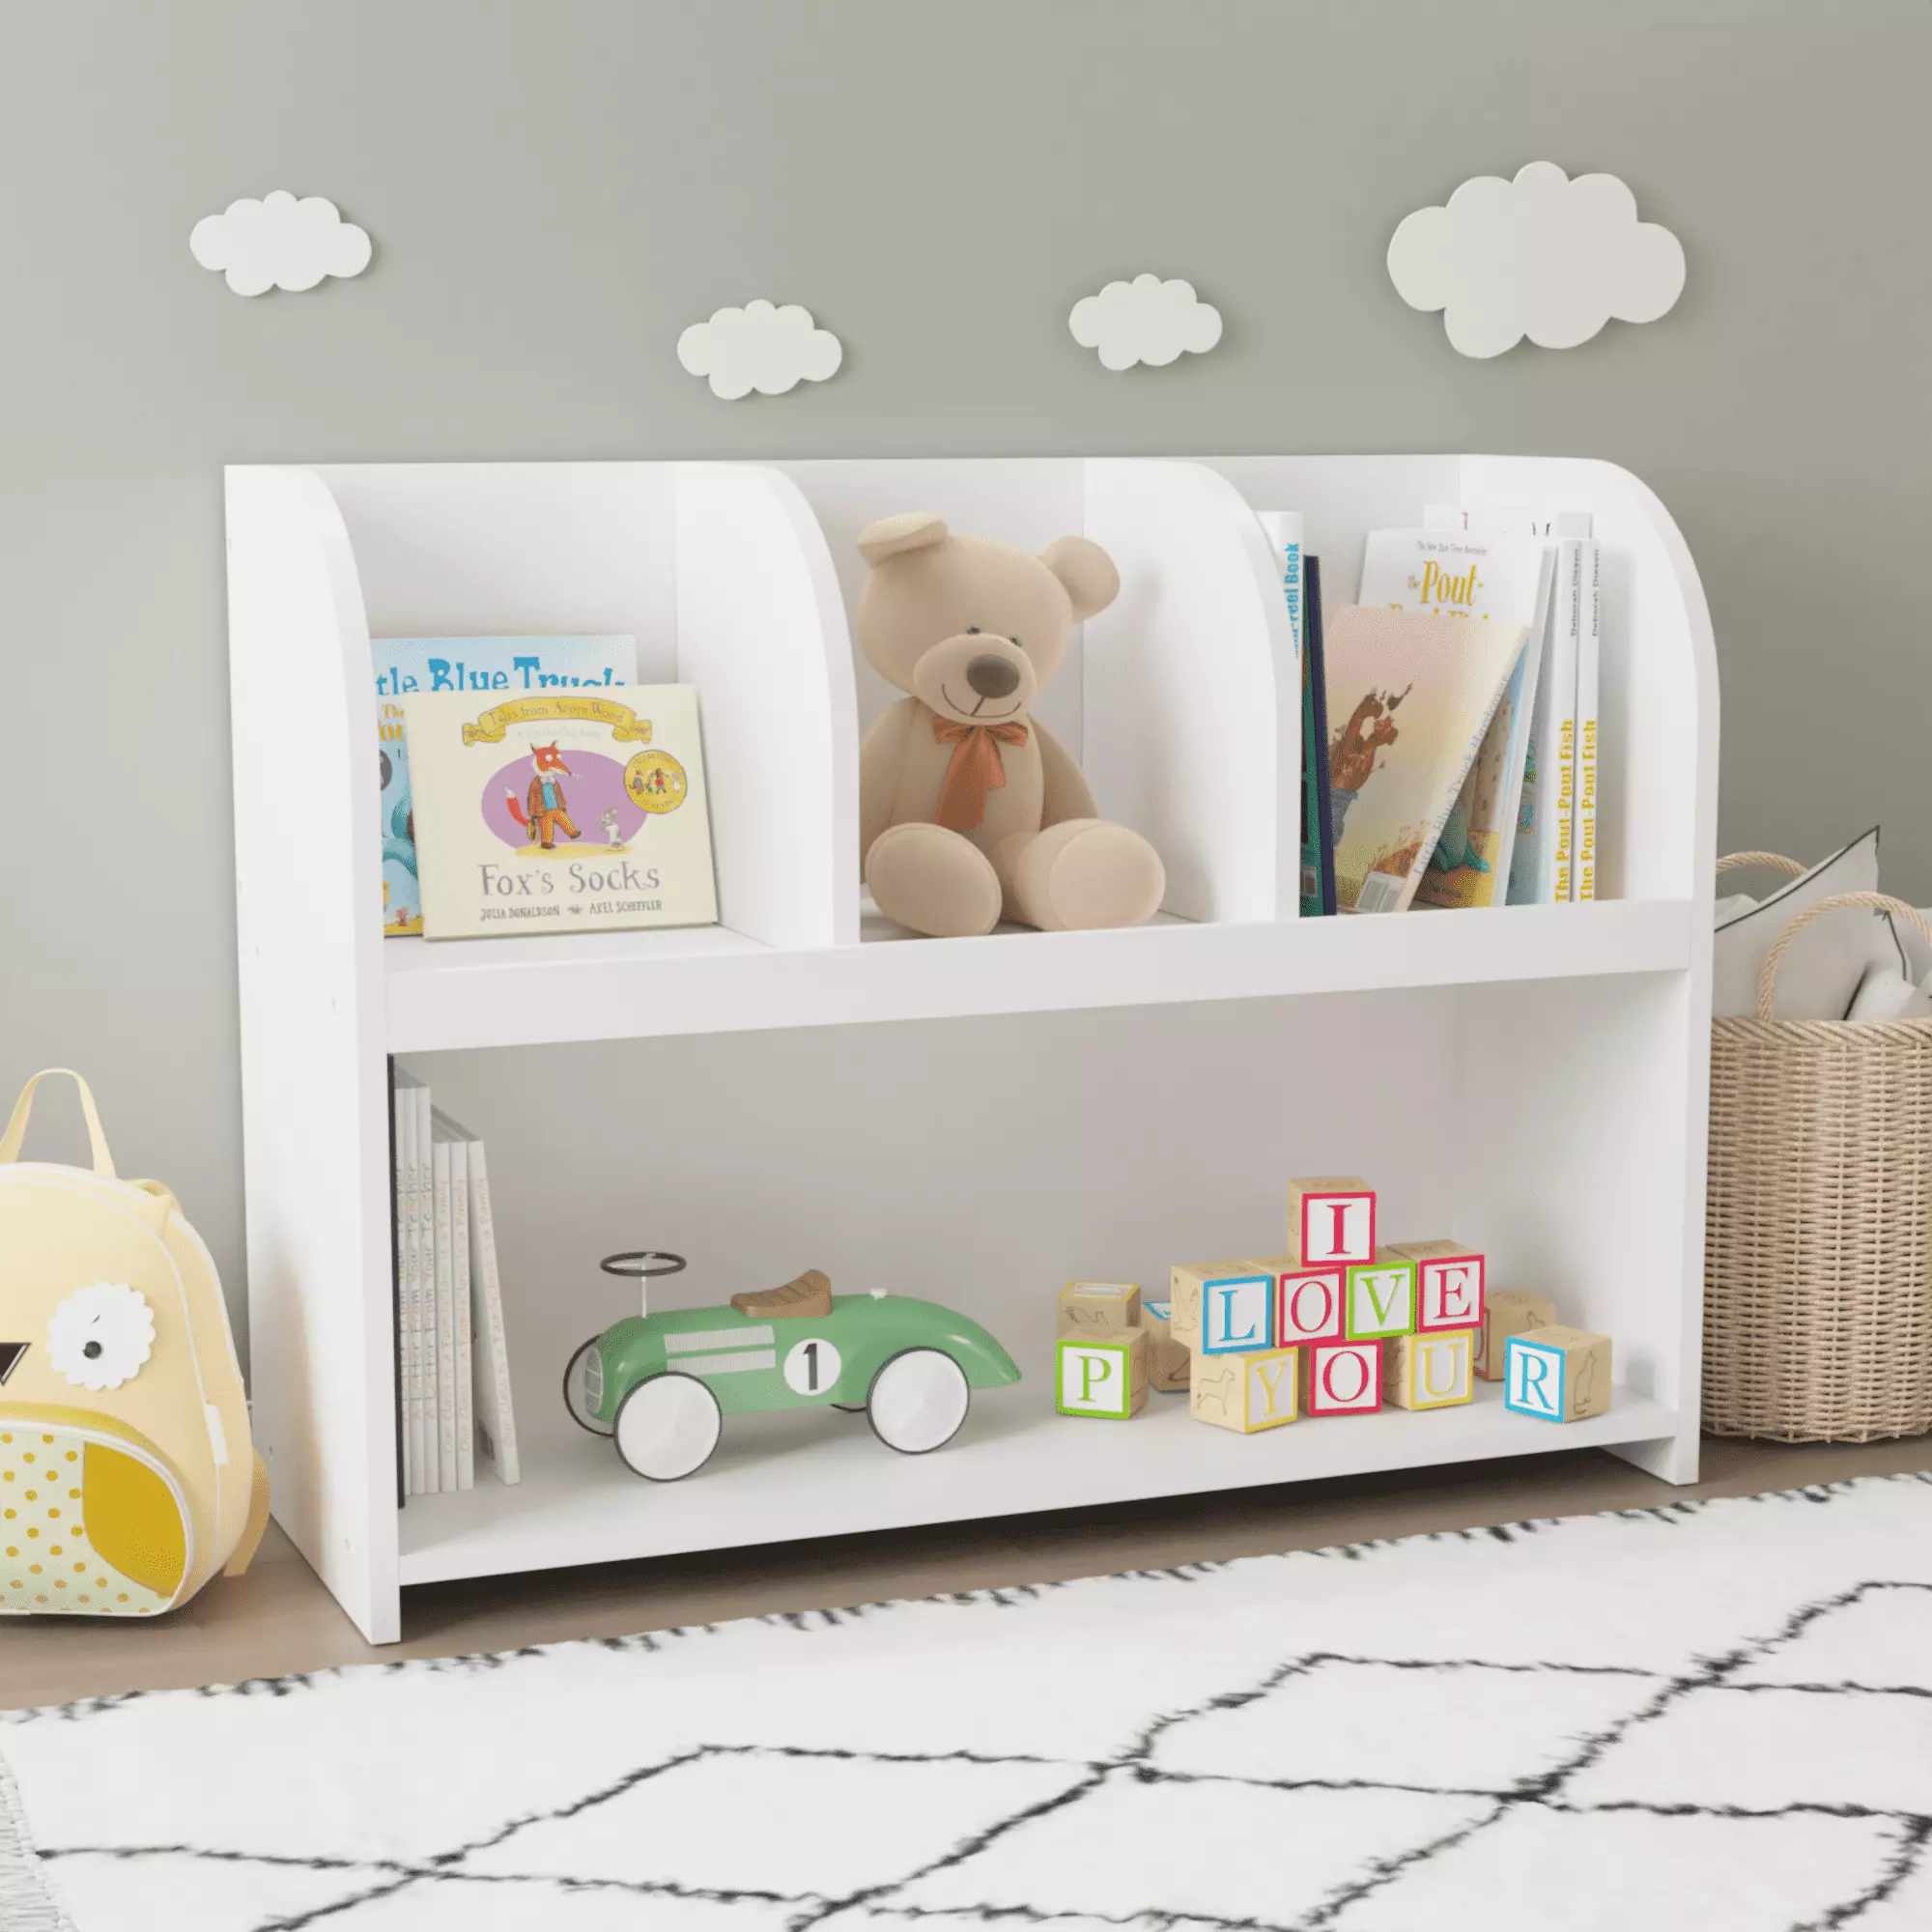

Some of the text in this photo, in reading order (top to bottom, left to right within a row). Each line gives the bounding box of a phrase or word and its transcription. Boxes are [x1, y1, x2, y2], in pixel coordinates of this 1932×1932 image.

[1284, 543, 1299, 583] Book
[428, 658, 509, 691] Blue
[1554, 720, 1574, 902] The Pout-Pout Fish
[1579, 720, 1596, 902] The Pout-Pout Fish
[478, 861, 661, 895] Fox's Socks
[480, 899, 663, 922] JULIA DONALDSON AXEL SCHEFFLER
[406, 1163, 418, 1239] Teacher
[1325, 1204, 1352, 1256] I
[803, 1343, 818, 1391] 1
[1076, 1354, 1112, 1404] P
[1517, 1351, 1555, 1411] R
